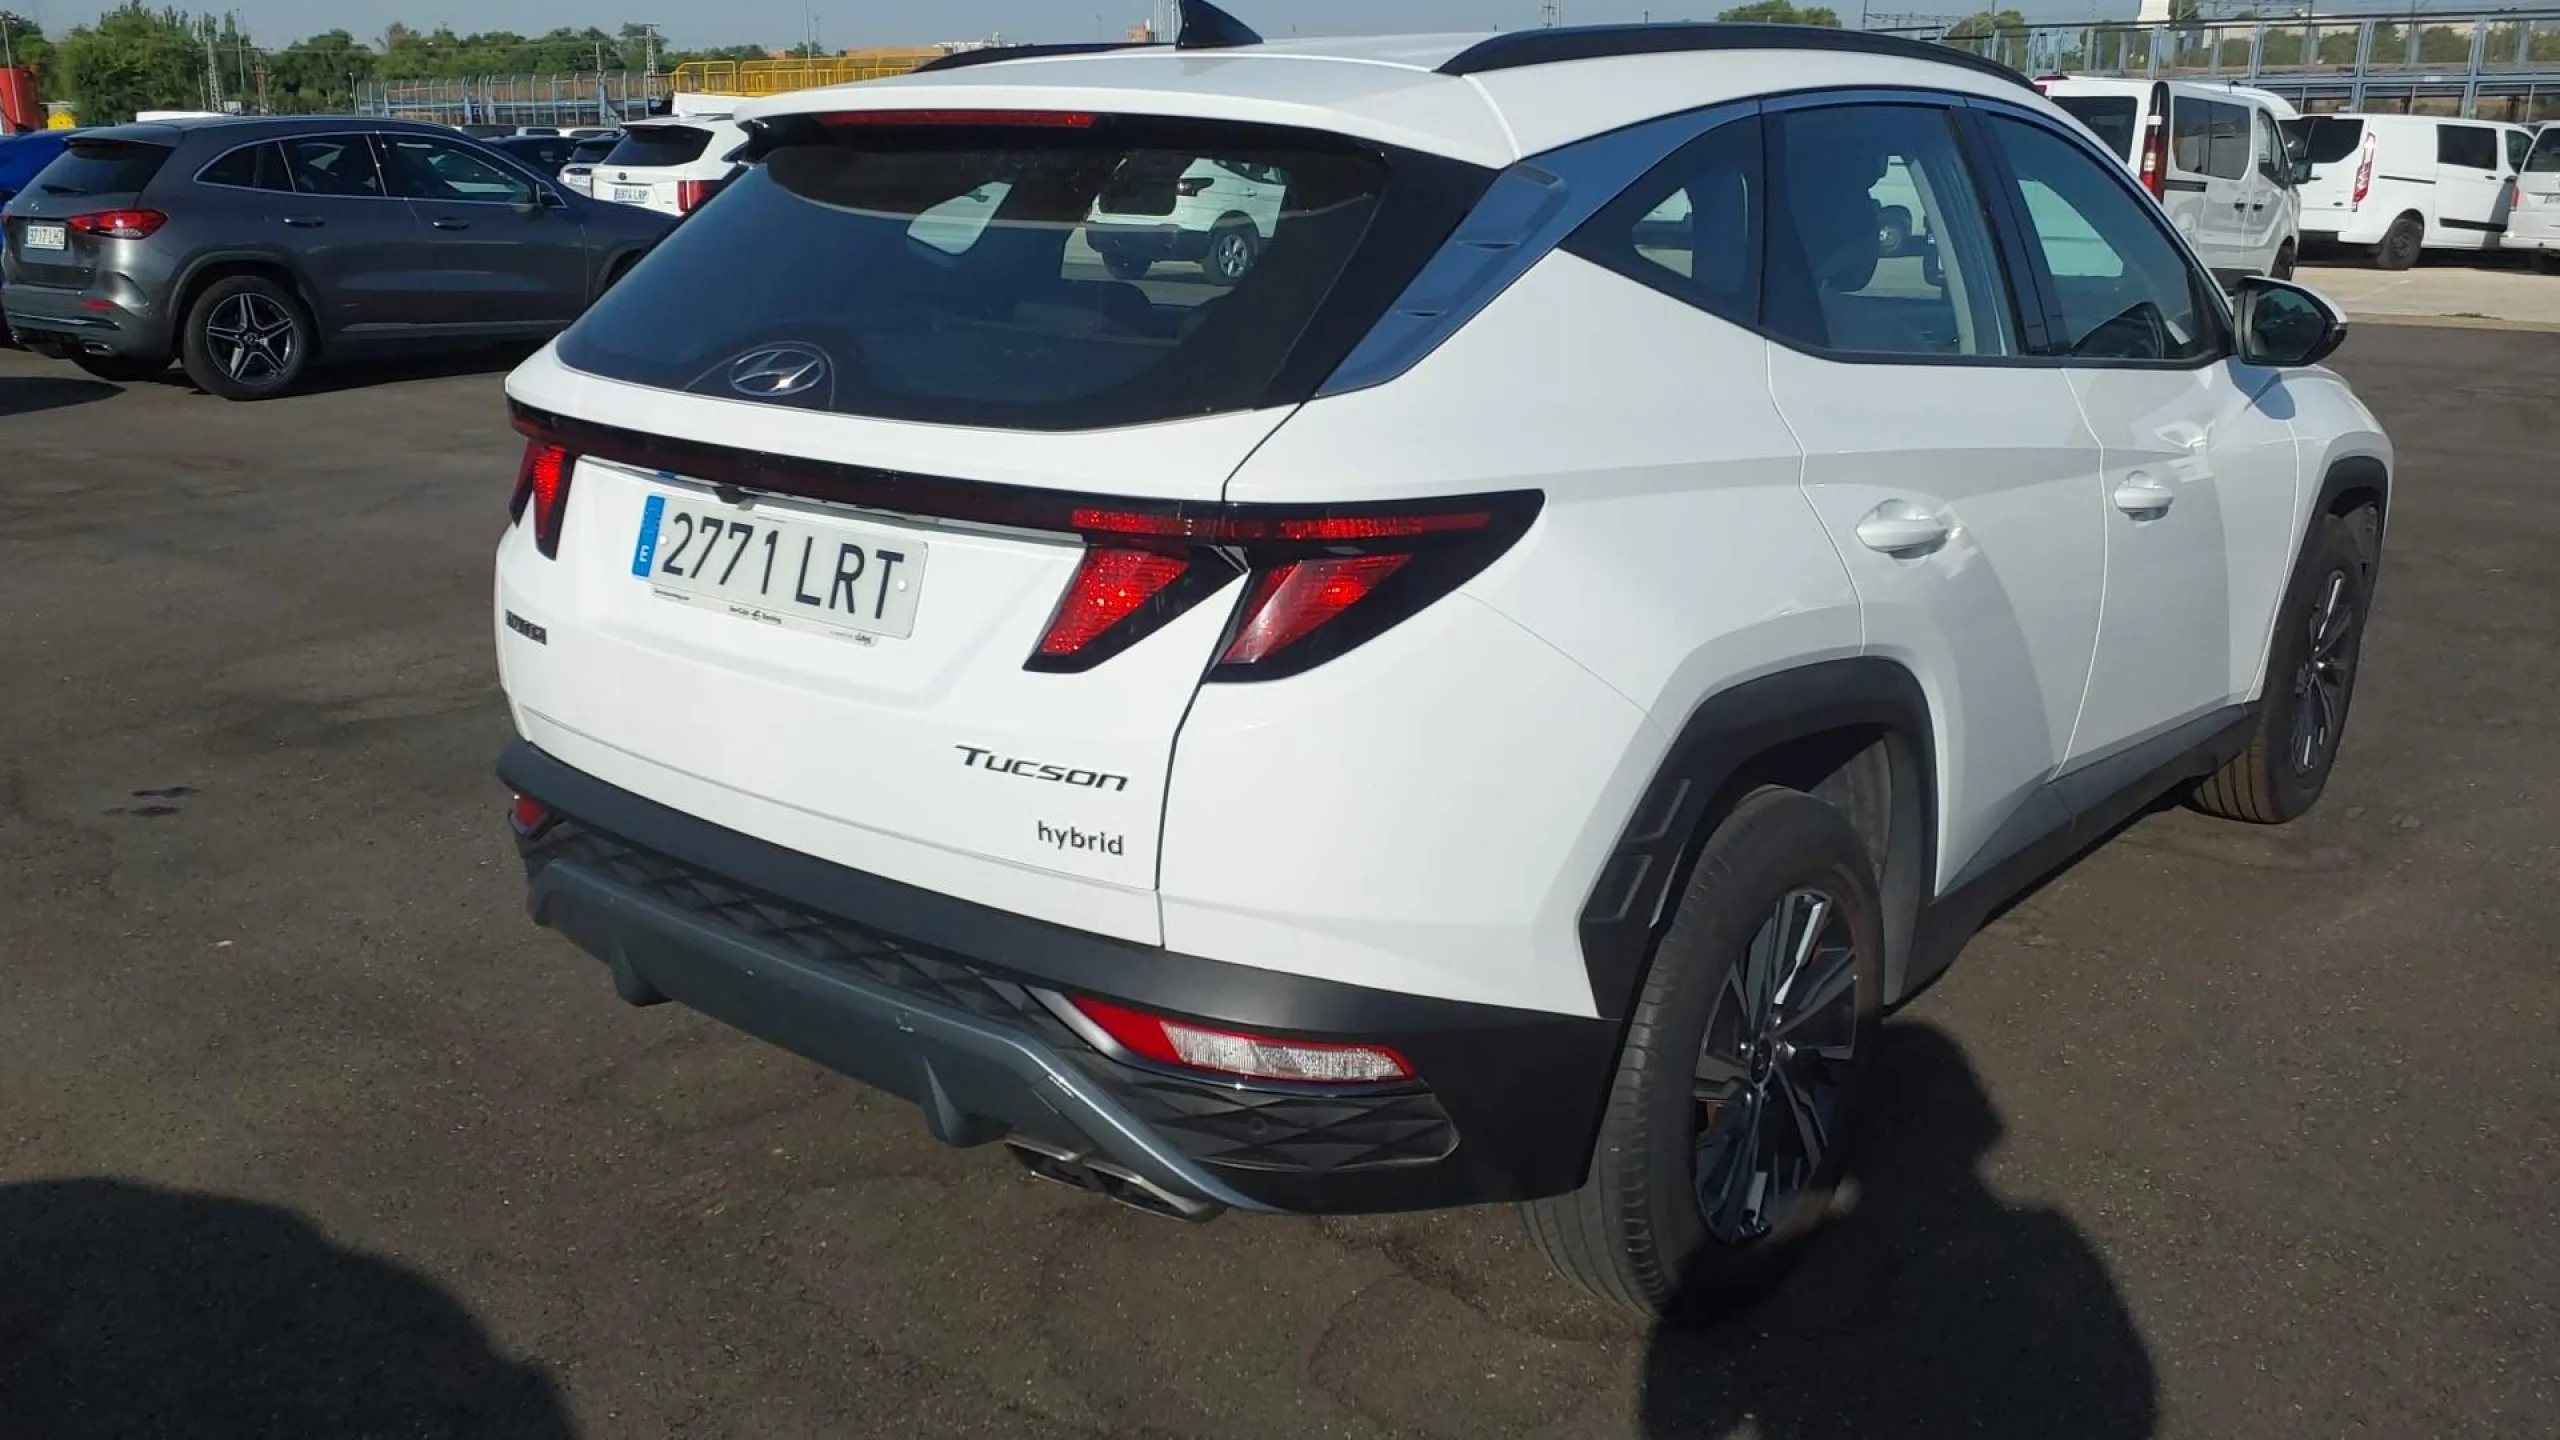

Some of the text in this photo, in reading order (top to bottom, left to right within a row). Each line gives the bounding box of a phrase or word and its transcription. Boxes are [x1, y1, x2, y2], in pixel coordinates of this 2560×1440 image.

[640, 544, 650, 562] E
[661, 512, 904, 619] 2771 LRT
[1037, 820, 1124, 856] hybrid
